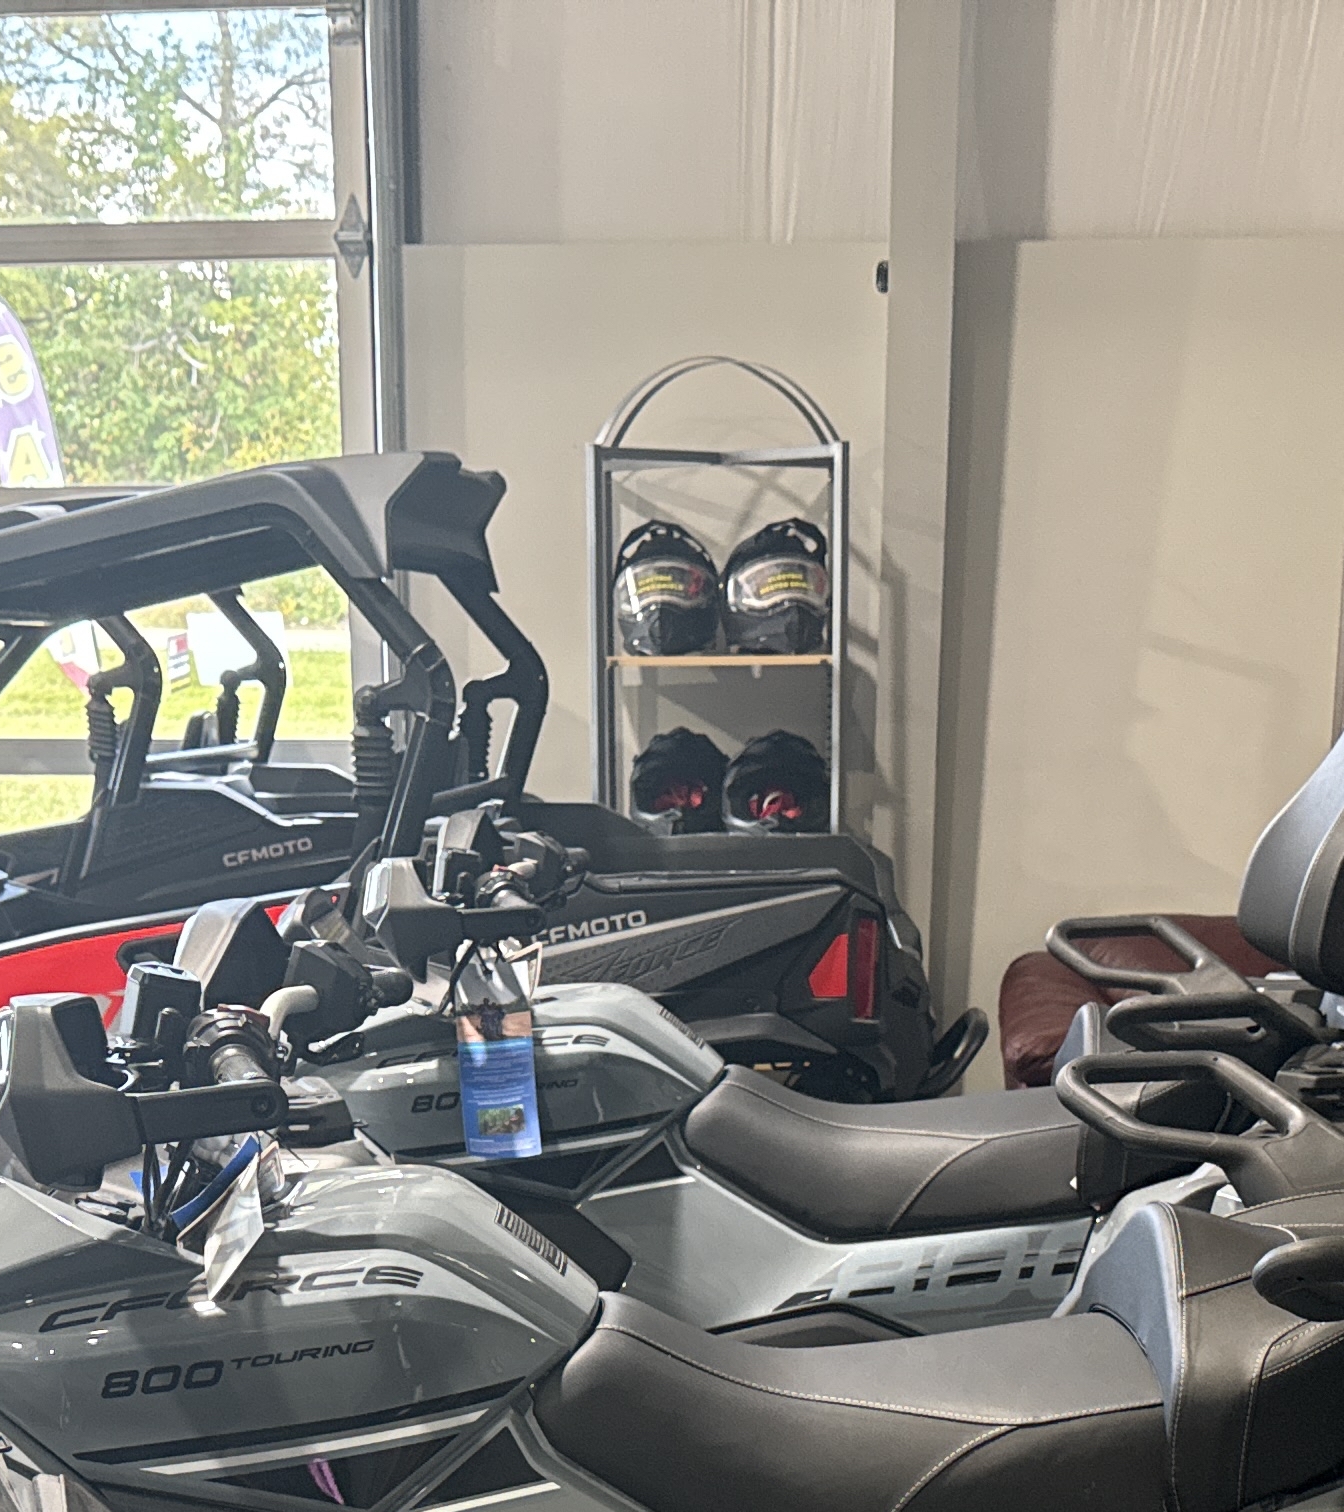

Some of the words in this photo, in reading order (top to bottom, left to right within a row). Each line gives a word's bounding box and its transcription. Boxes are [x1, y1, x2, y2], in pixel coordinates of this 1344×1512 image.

[221, 837, 313, 868] CFMOTO
[100, 1359, 226, 1400] 800
[229, 1338, 376, 1372] TOURING
